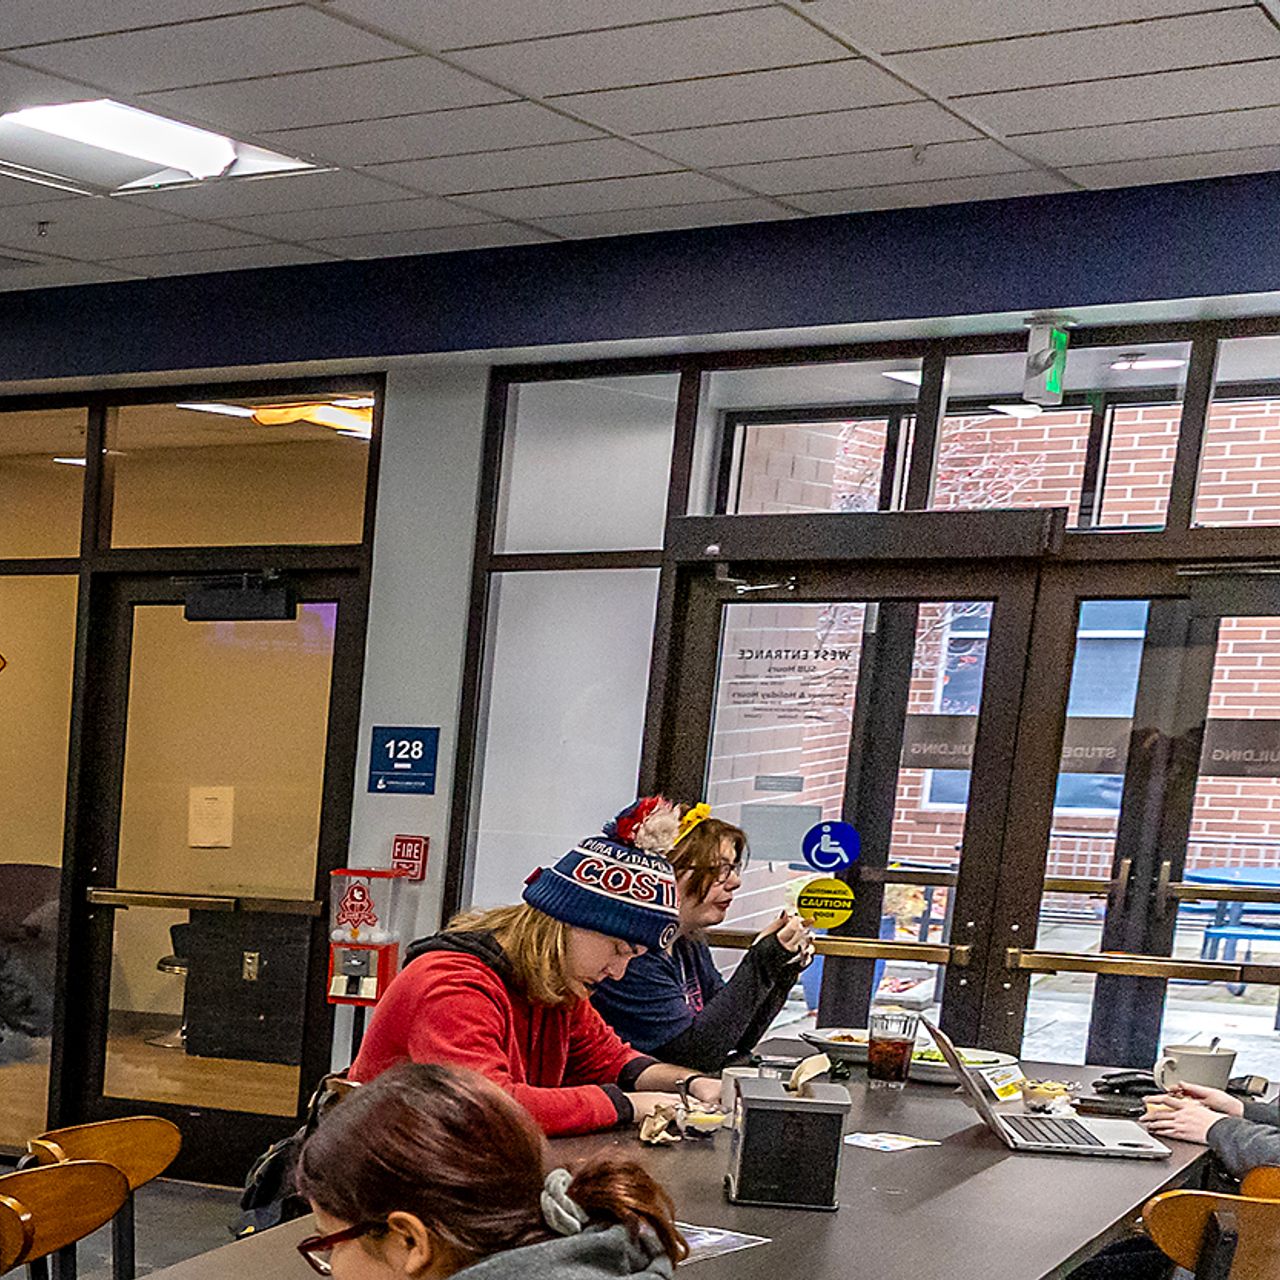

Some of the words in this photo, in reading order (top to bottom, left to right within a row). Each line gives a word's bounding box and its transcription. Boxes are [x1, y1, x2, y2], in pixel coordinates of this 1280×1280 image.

[384, 739, 424, 760] 128
[394, 841, 421, 860] FIRE
[583, 839, 614, 857] PURA
[800, 897, 853, 909] CAUTION
